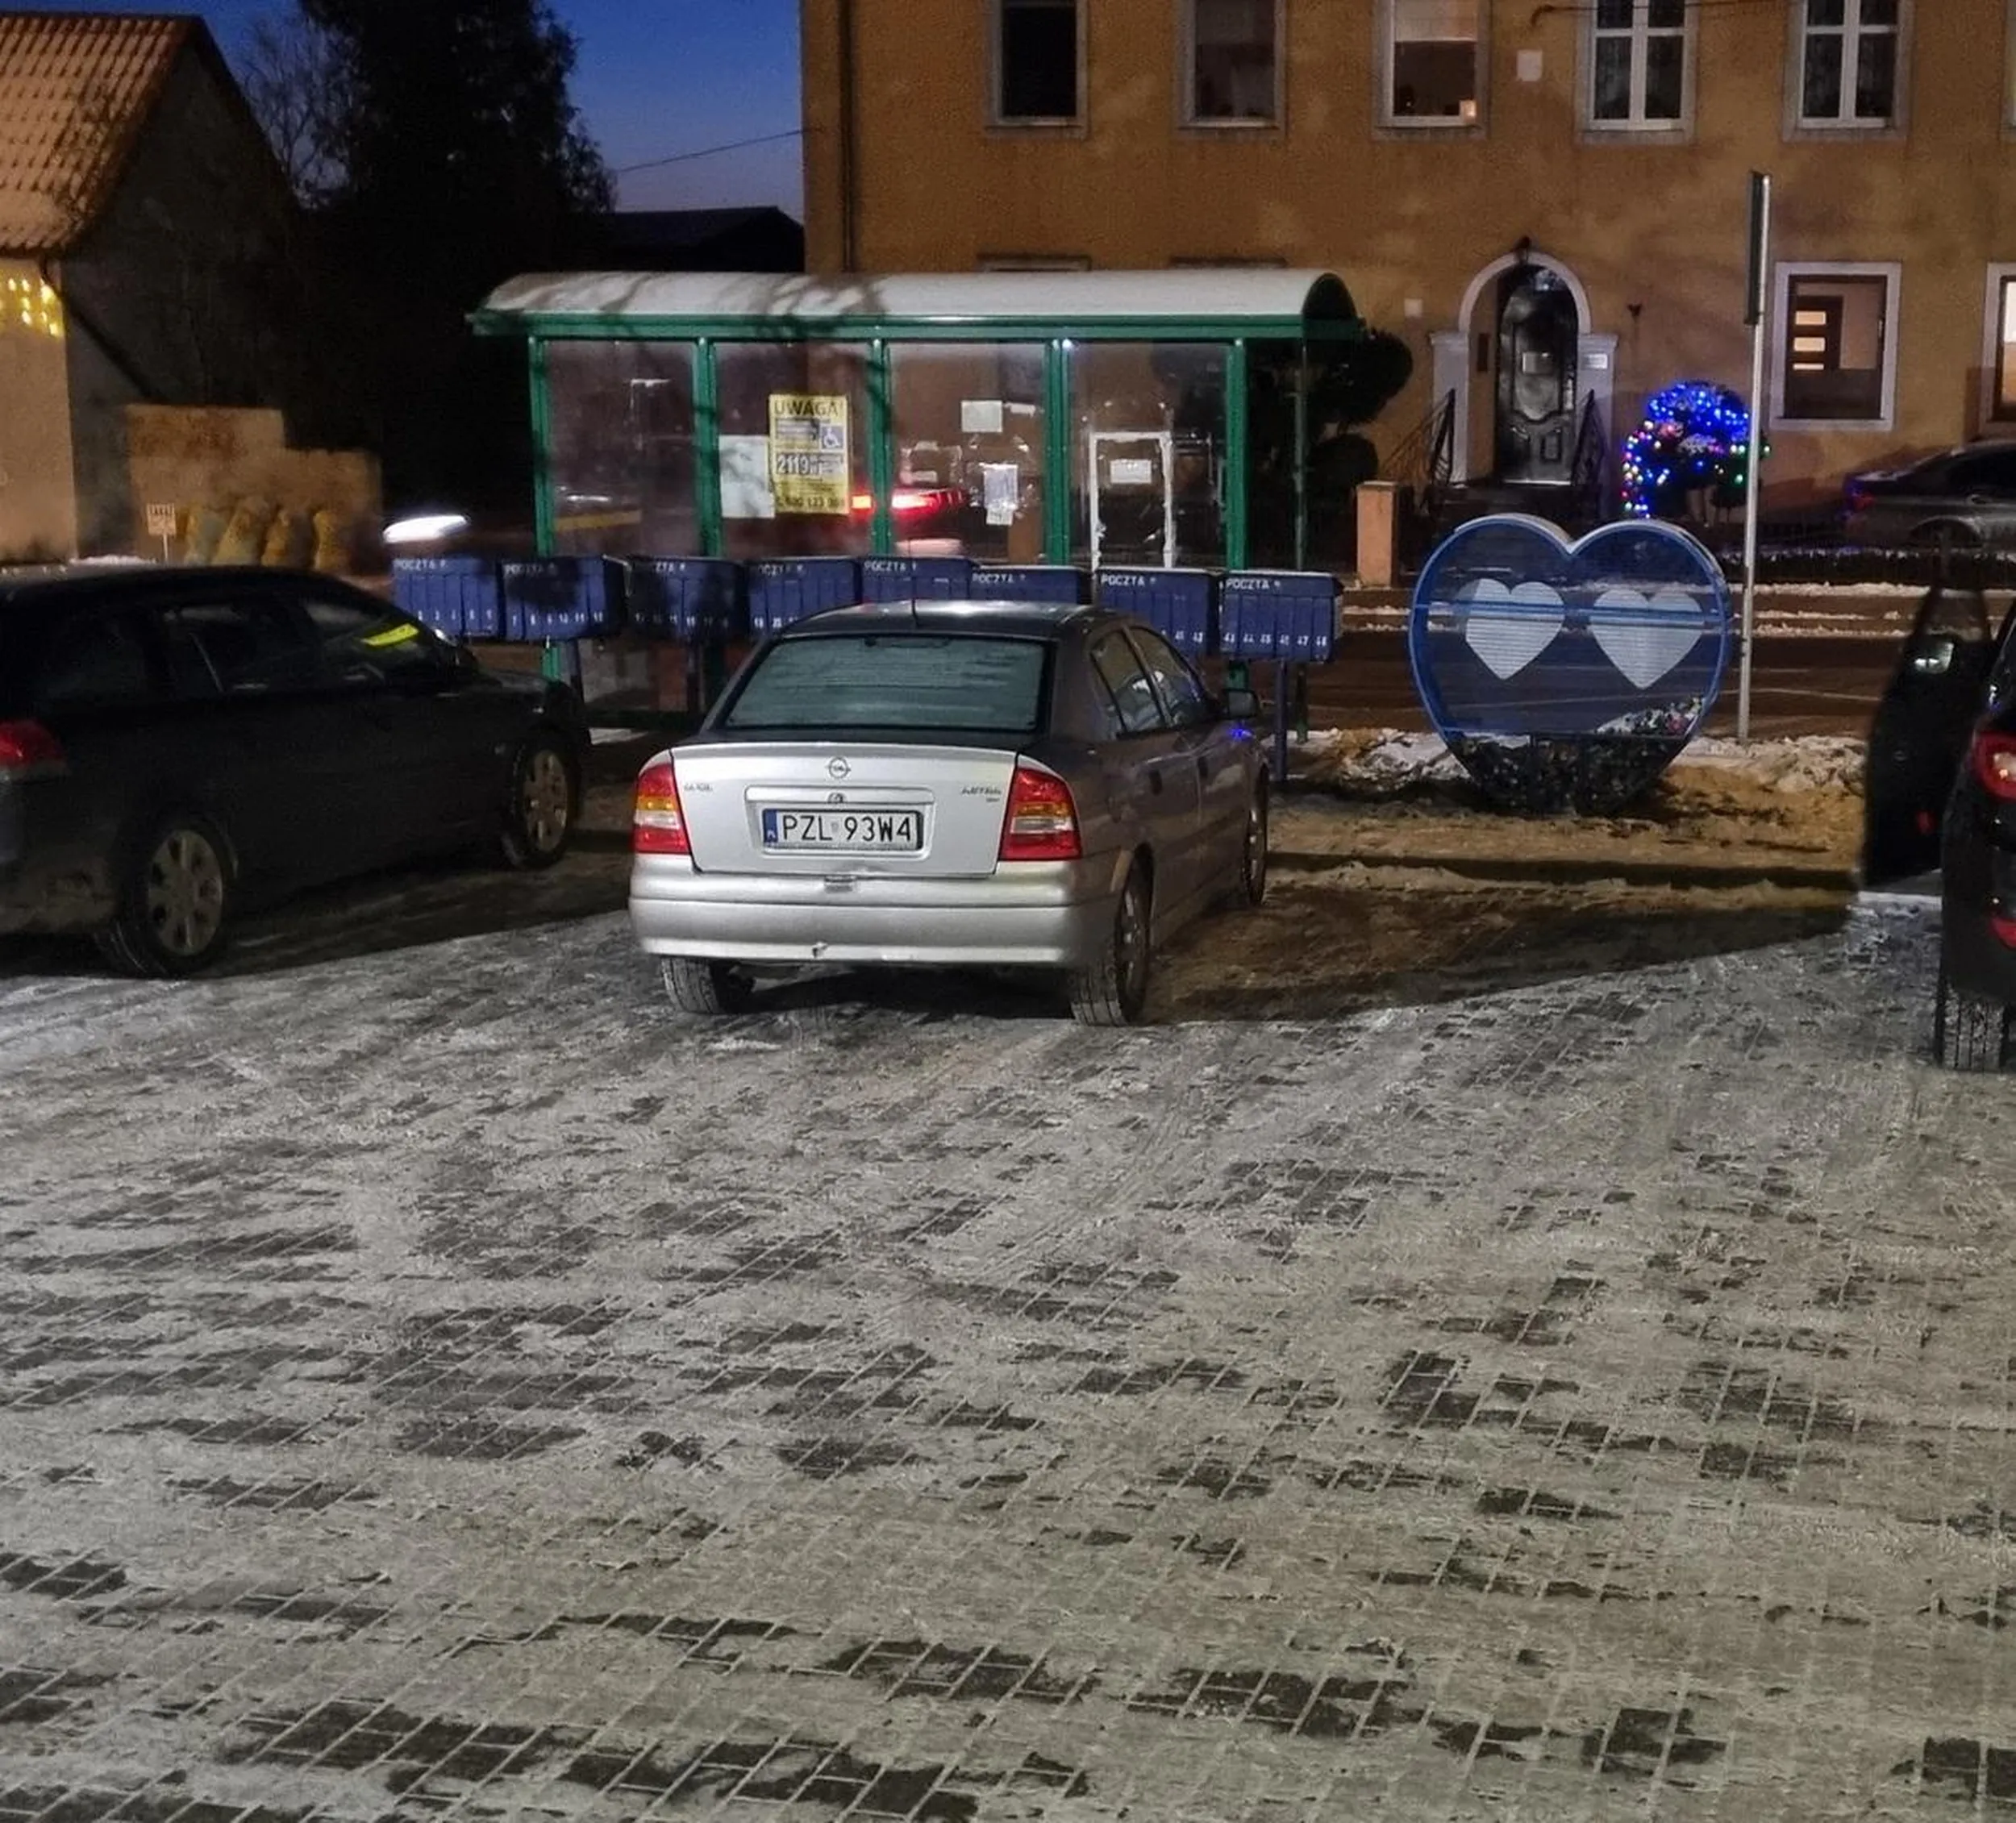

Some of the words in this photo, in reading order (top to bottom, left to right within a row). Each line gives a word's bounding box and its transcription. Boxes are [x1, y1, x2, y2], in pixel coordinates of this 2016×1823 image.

[864, 560, 907, 572] POCZTA
[972, 572, 1014, 584] POCZTA
[1100, 573, 1145, 586] POCZTA
[1225, 577, 1270, 589] POCZTA
[781, 814, 833, 841] PZL
[843, 815, 911, 843] 93W4
